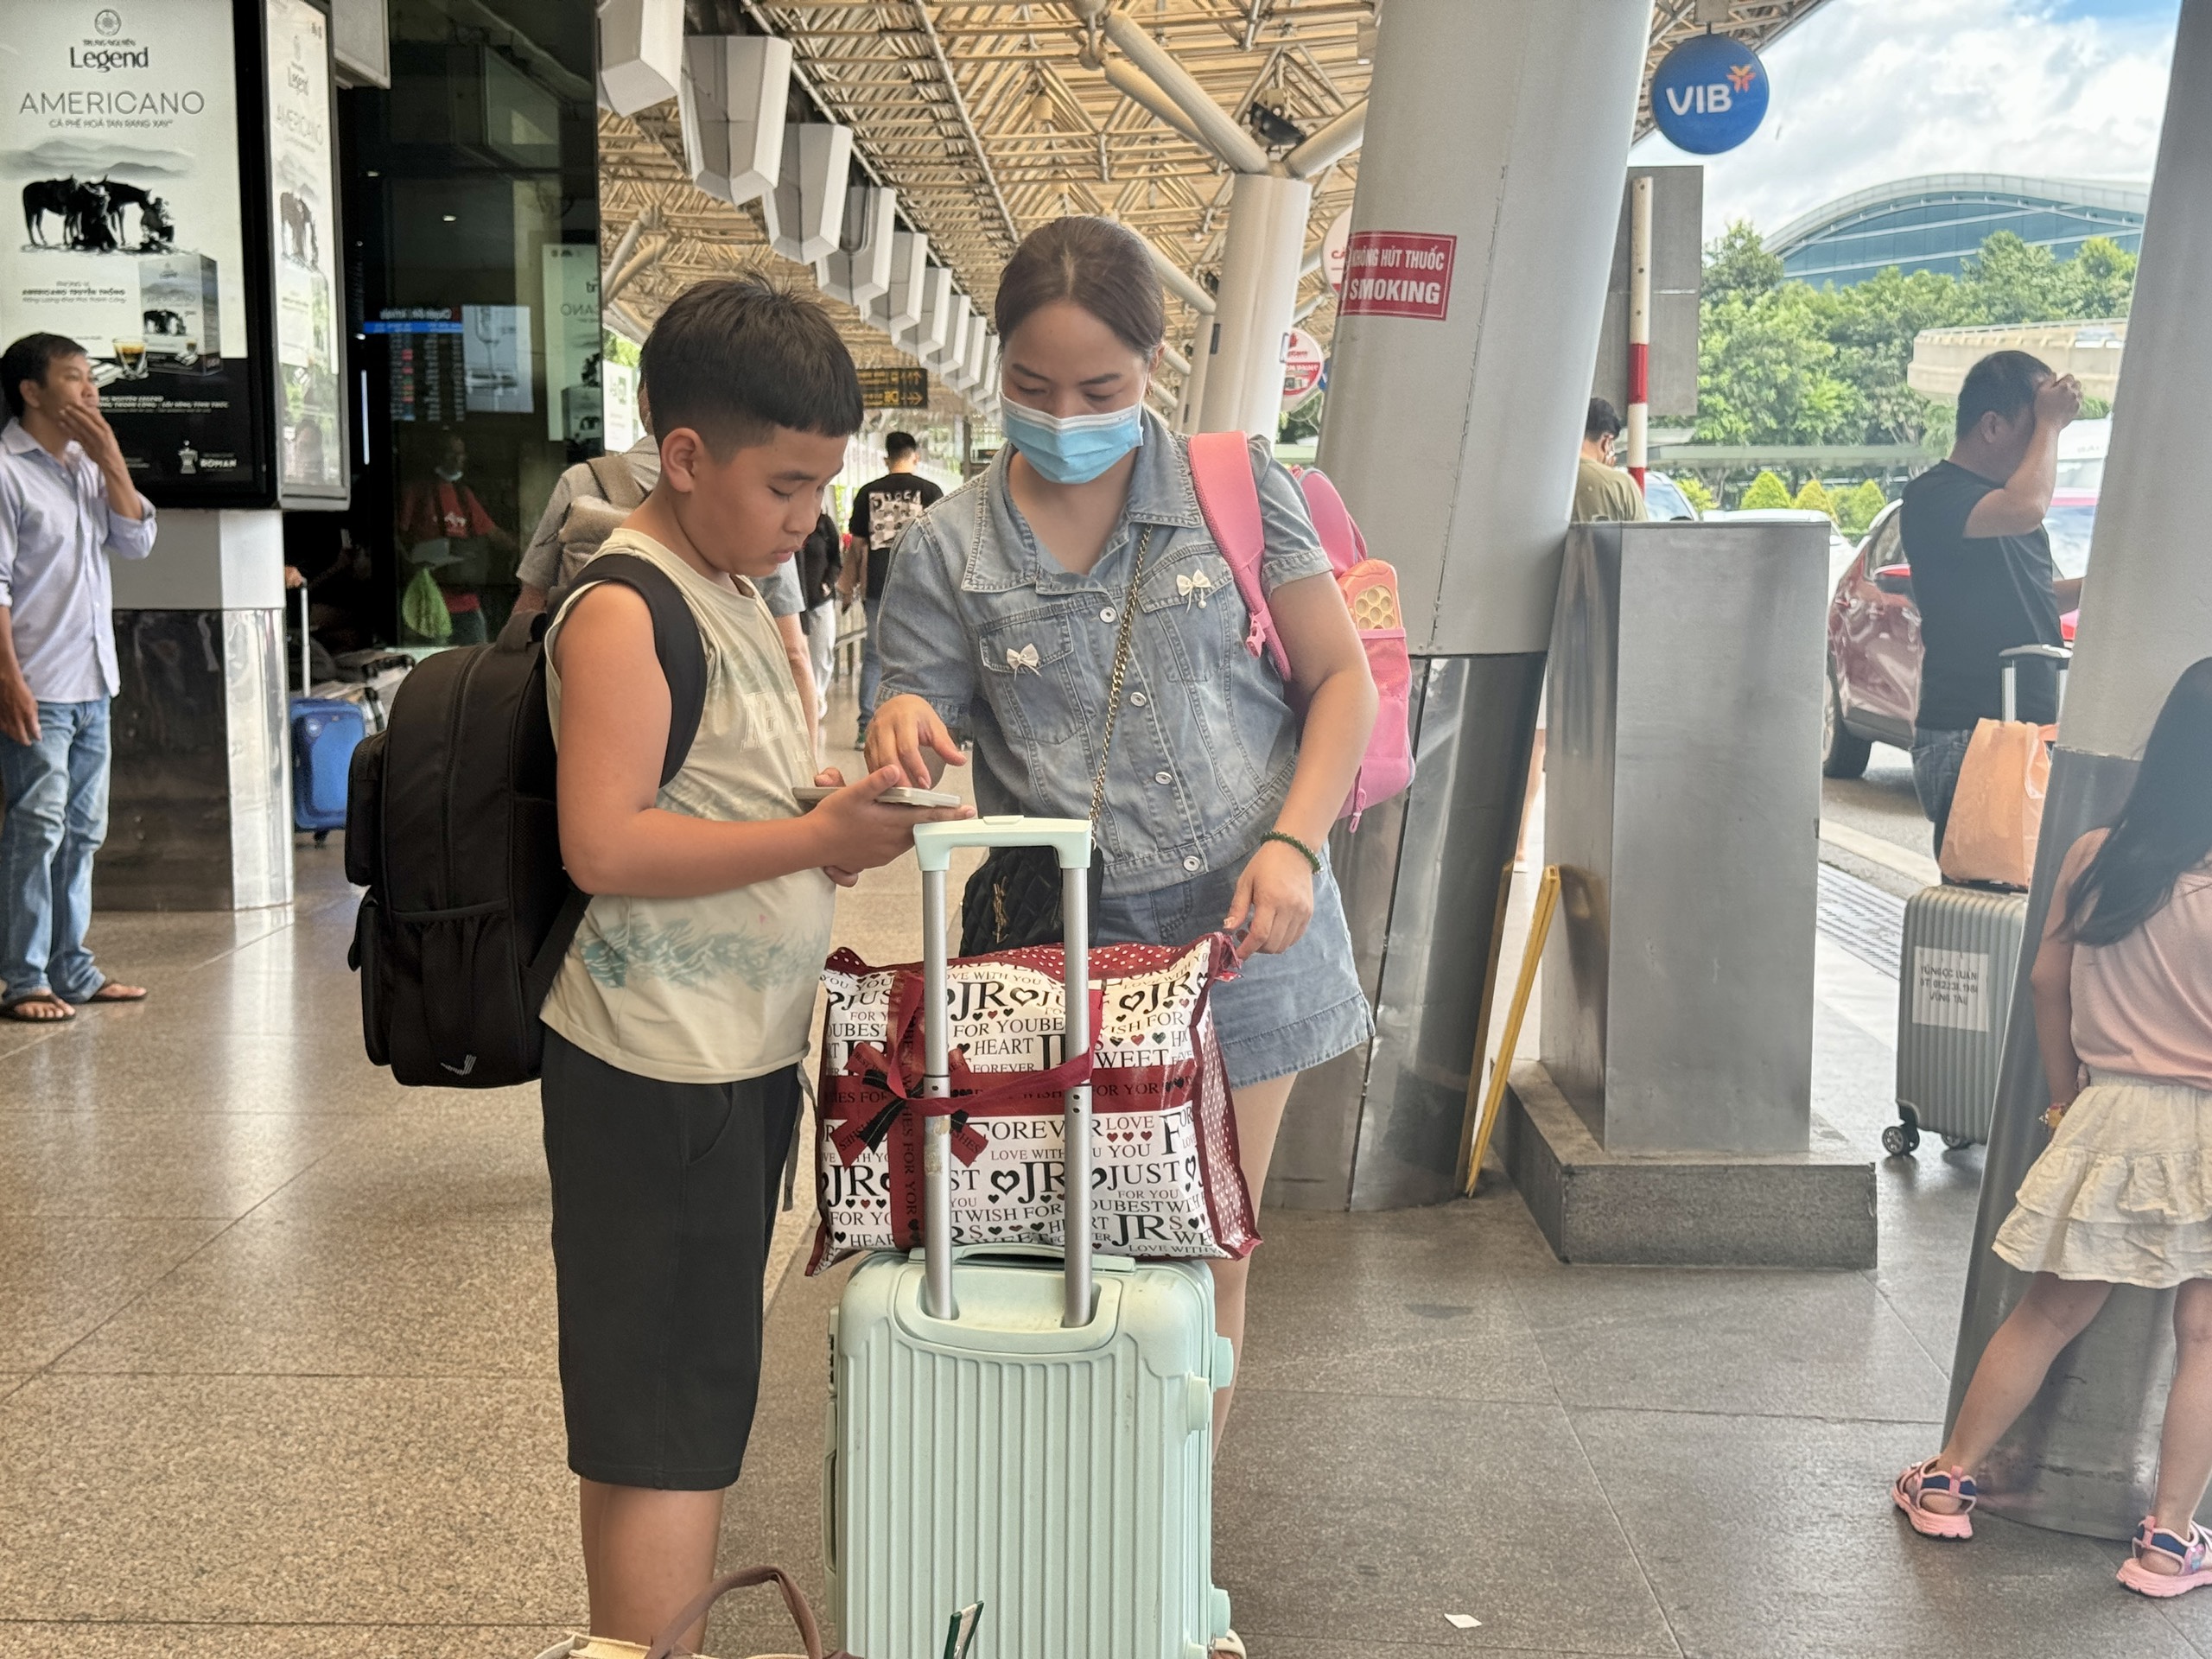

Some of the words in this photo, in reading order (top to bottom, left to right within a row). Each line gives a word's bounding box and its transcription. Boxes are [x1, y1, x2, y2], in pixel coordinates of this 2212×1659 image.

[69, 46, 149, 73] Legend
[19, 91, 205, 114] AMERICANO
[1666, 84, 1732, 116] VIB
[1405, 245, 1445, 270] THUỐC
[1350, 278, 1441, 305] SMOKING
[973, 970, 1008, 981] WITH
[1013, 976, 1042, 986] YOU
[950, 981, 1009, 1021] JR
[1143, 970, 1196, 1015] JR
[850, 1011, 875, 1021] FOR
[1147, 1011, 1185, 1027] FOR
[953, 1022, 990, 1038] FOR
[975, 1038, 1034, 1056] HEART
[1093, 1084, 1120, 1097] OR
[1124, 1082, 1160, 1096] YOR
[1106, 1116, 1154, 1130] LOVE
[903, 1141, 915, 1174] FOR
[991, 1150, 1028, 1160] LOVE
[1108, 1143, 1151, 1158] YOU
[1017, 1161, 1065, 1204] JR
[1107, 1160, 1180, 1191] JUST
[827, 1165, 880, 1207] JR
[1118, 1190, 1145, 1199] FOR
[1149, 1189, 1179, 1199] YOU
[830, 1211, 865, 1225] FOR
[1023, 1203, 1064, 1219] FOR
[1112, 1213, 1173, 1247] JR
[1128, 1244, 1166, 1253] LOVE
